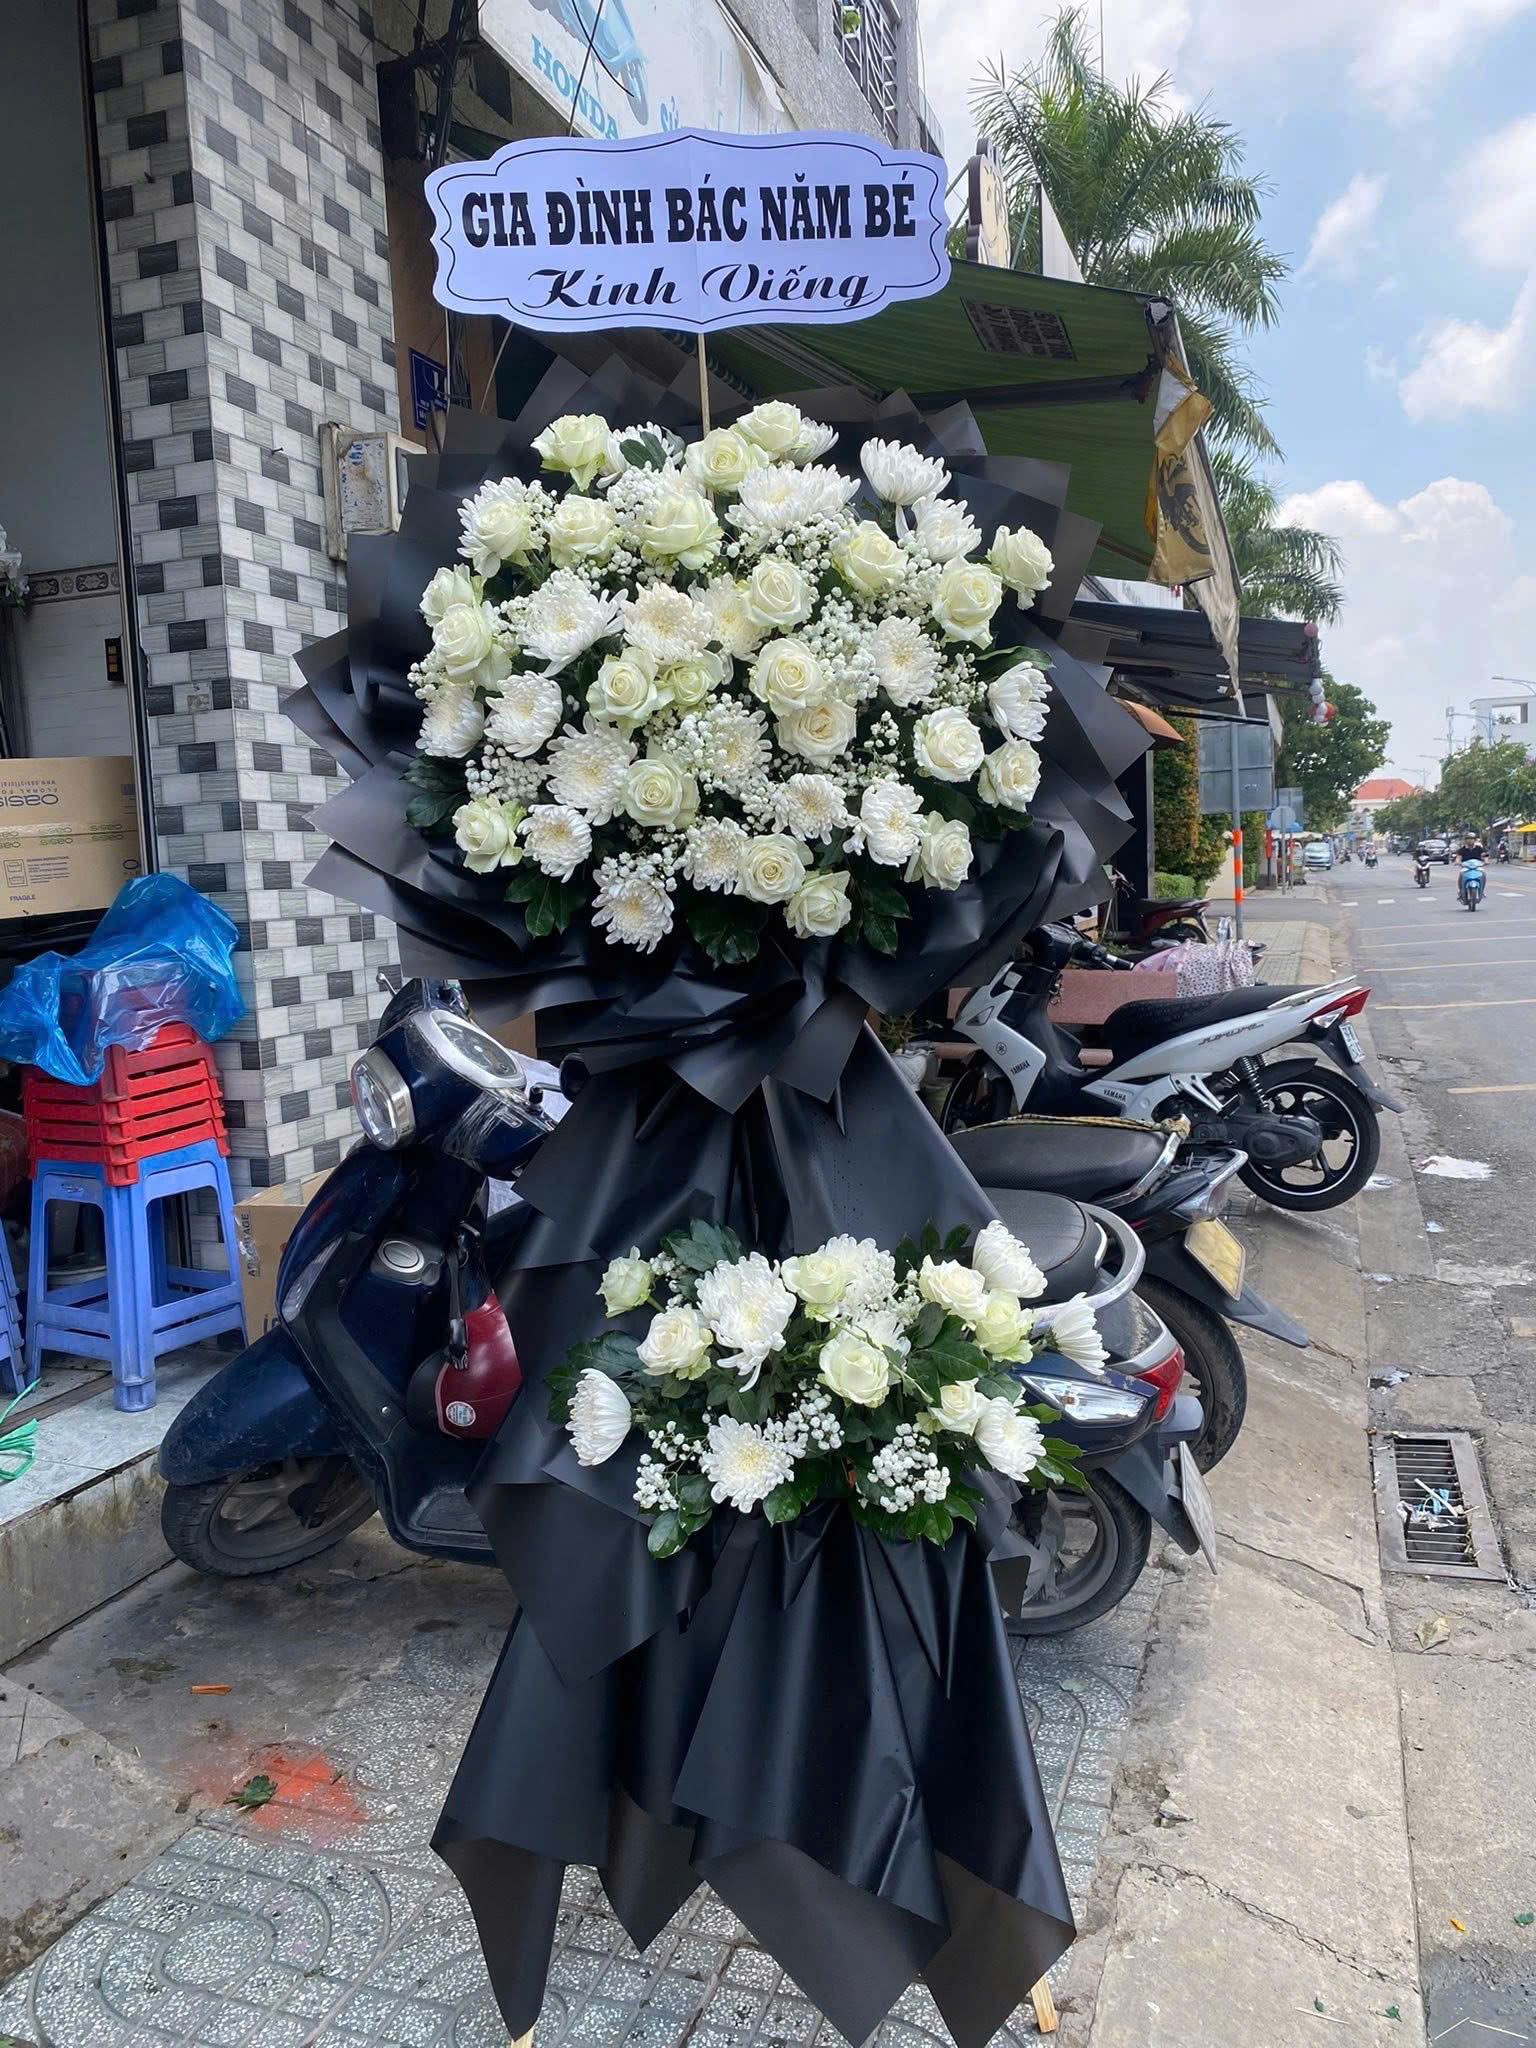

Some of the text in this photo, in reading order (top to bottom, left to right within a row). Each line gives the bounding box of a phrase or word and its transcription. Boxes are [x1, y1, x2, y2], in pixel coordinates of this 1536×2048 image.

[531, 34, 619, 139] HONDA
[462, 171, 916, 248] GIA ĐÌNH BÁC NĂM BÉ
[522, 264, 873, 309] Kính Viếng
[1010, 1059, 1031, 1075] YAMAHA
[1103, 1088, 1127, 1102] YAMAHA
